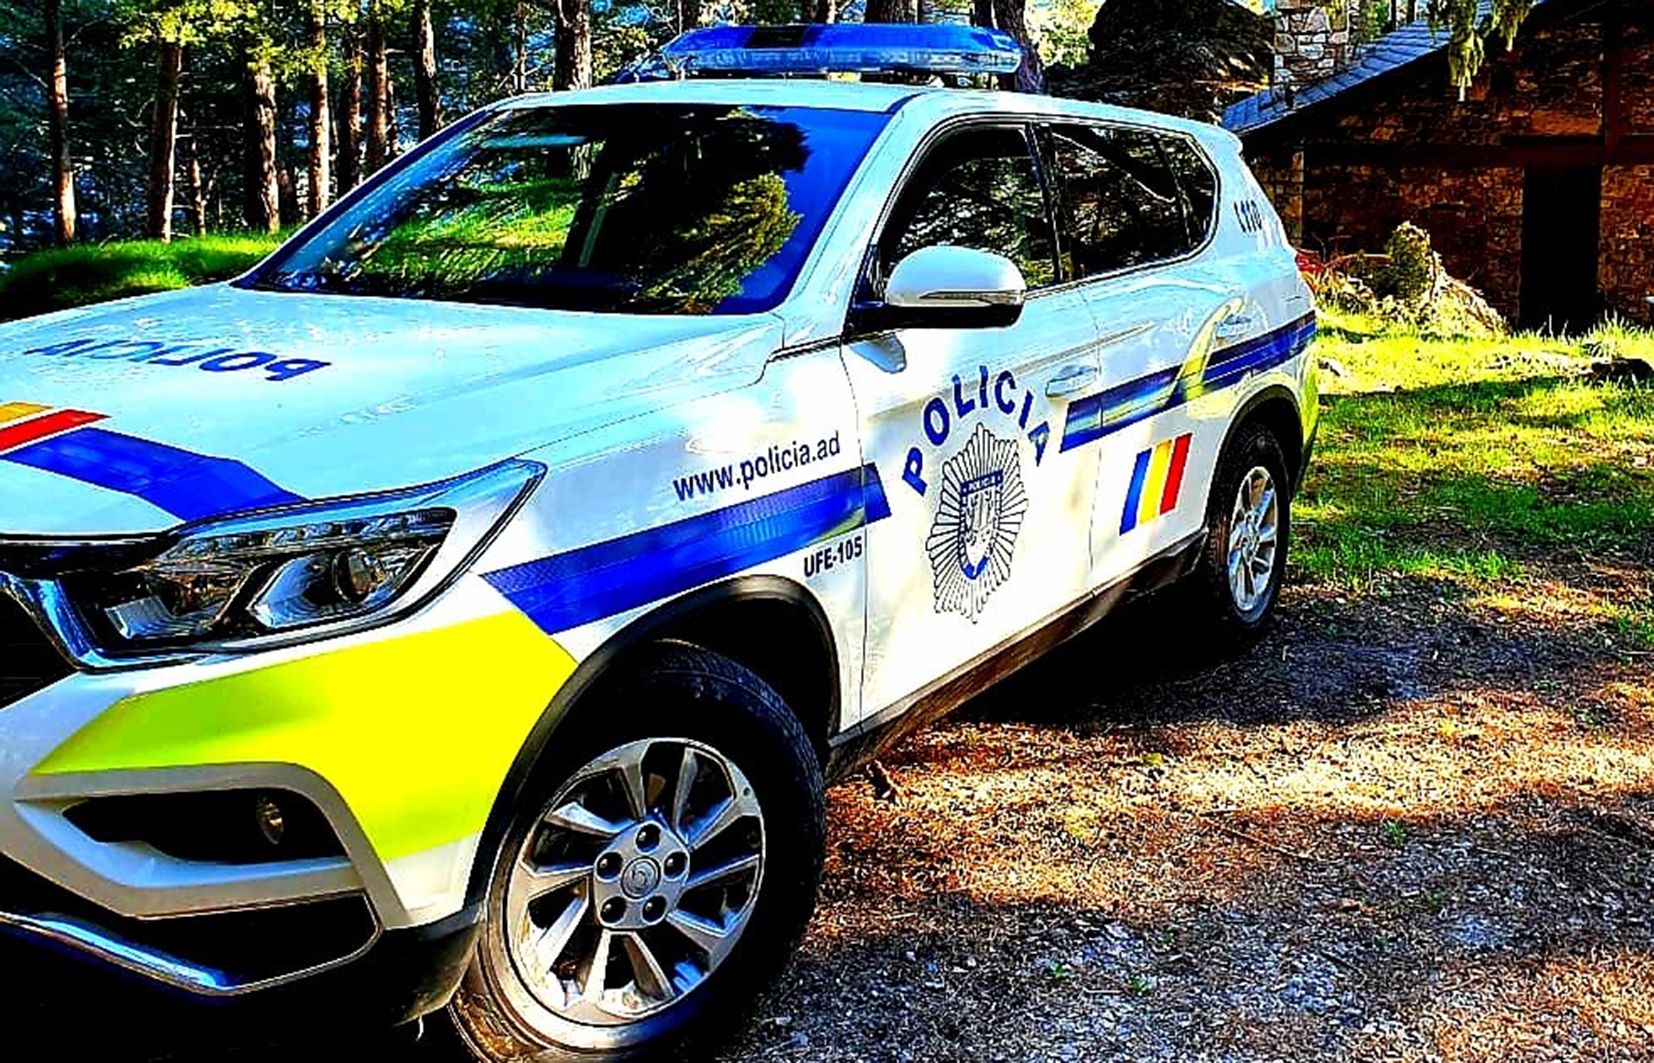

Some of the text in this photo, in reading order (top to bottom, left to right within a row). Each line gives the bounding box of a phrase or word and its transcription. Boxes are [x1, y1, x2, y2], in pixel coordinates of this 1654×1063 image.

[672, 429, 842, 502] www.policia.ad
[902, 364, 1051, 497] POLICIA
[803, 535, 863, 578] UFE-105
